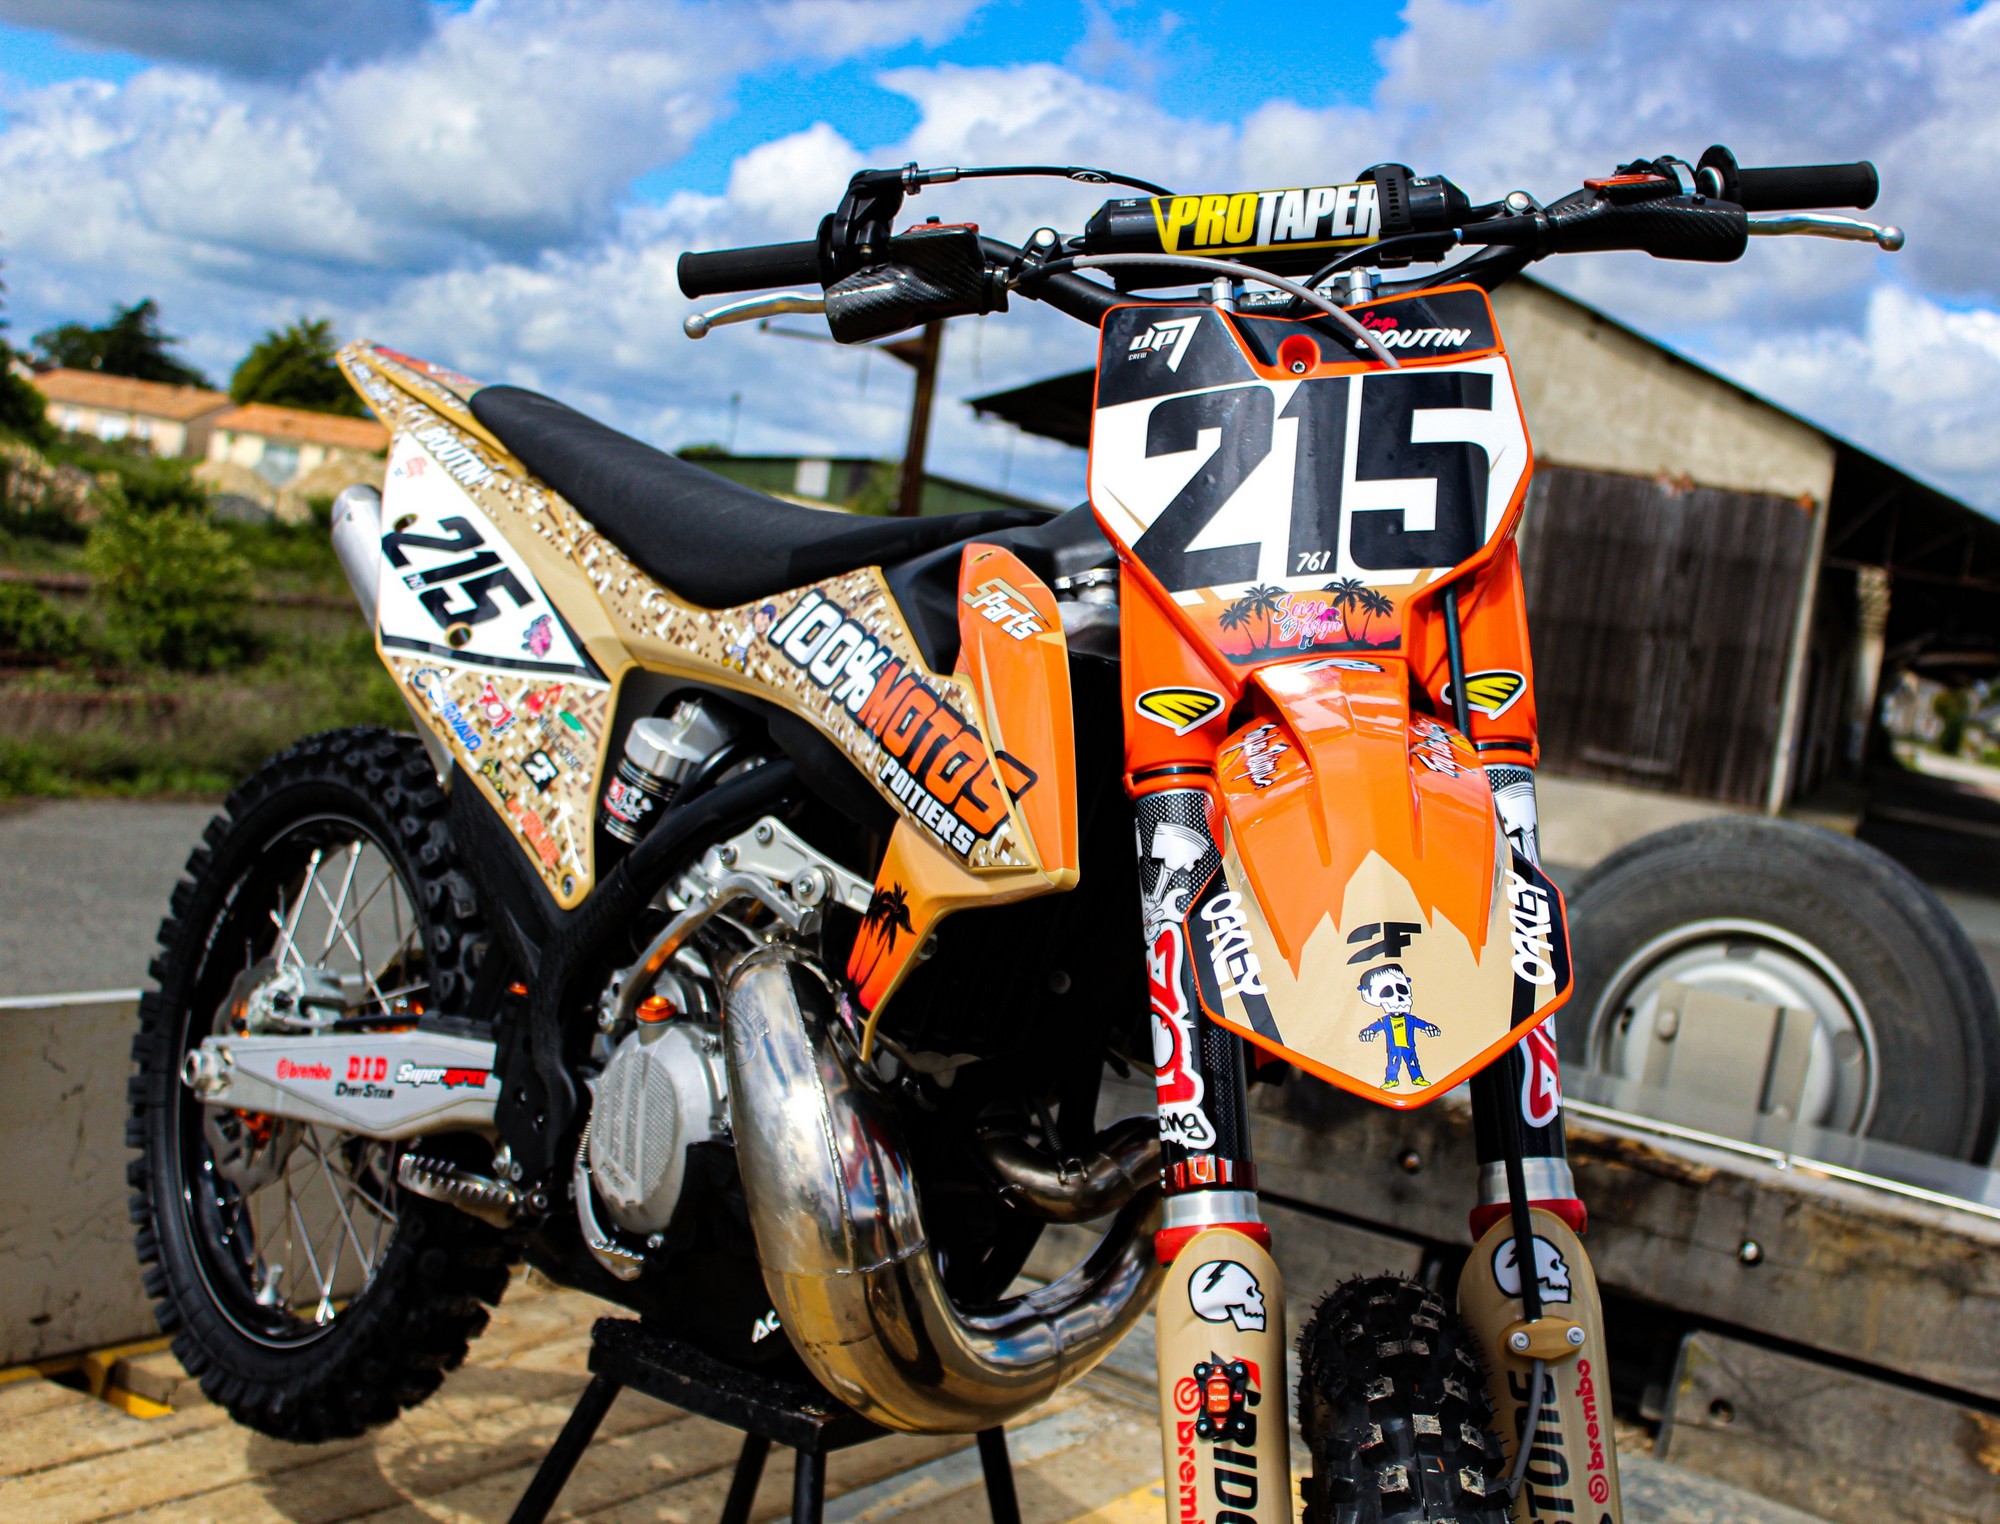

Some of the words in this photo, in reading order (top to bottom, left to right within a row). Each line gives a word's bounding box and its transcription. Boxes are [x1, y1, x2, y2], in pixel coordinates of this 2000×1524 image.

[1128, 352, 1147, 361] CREW
[1132, 372, 1493, 593] 215
[381, 516, 534, 628] 215
[1297, 551, 1331, 572] 761
[880, 753, 976, 855] POITIERS
[1200, 891, 1269, 1000] OAKLEY
[1505, 868, 1556, 985] OAKLEY
[289, 1060, 332, 1080] brembo
[347, 1056, 388, 1082] DID
[1575, 1359, 1605, 1471] brembo
[1177, 1421, 1205, 1524] brem
